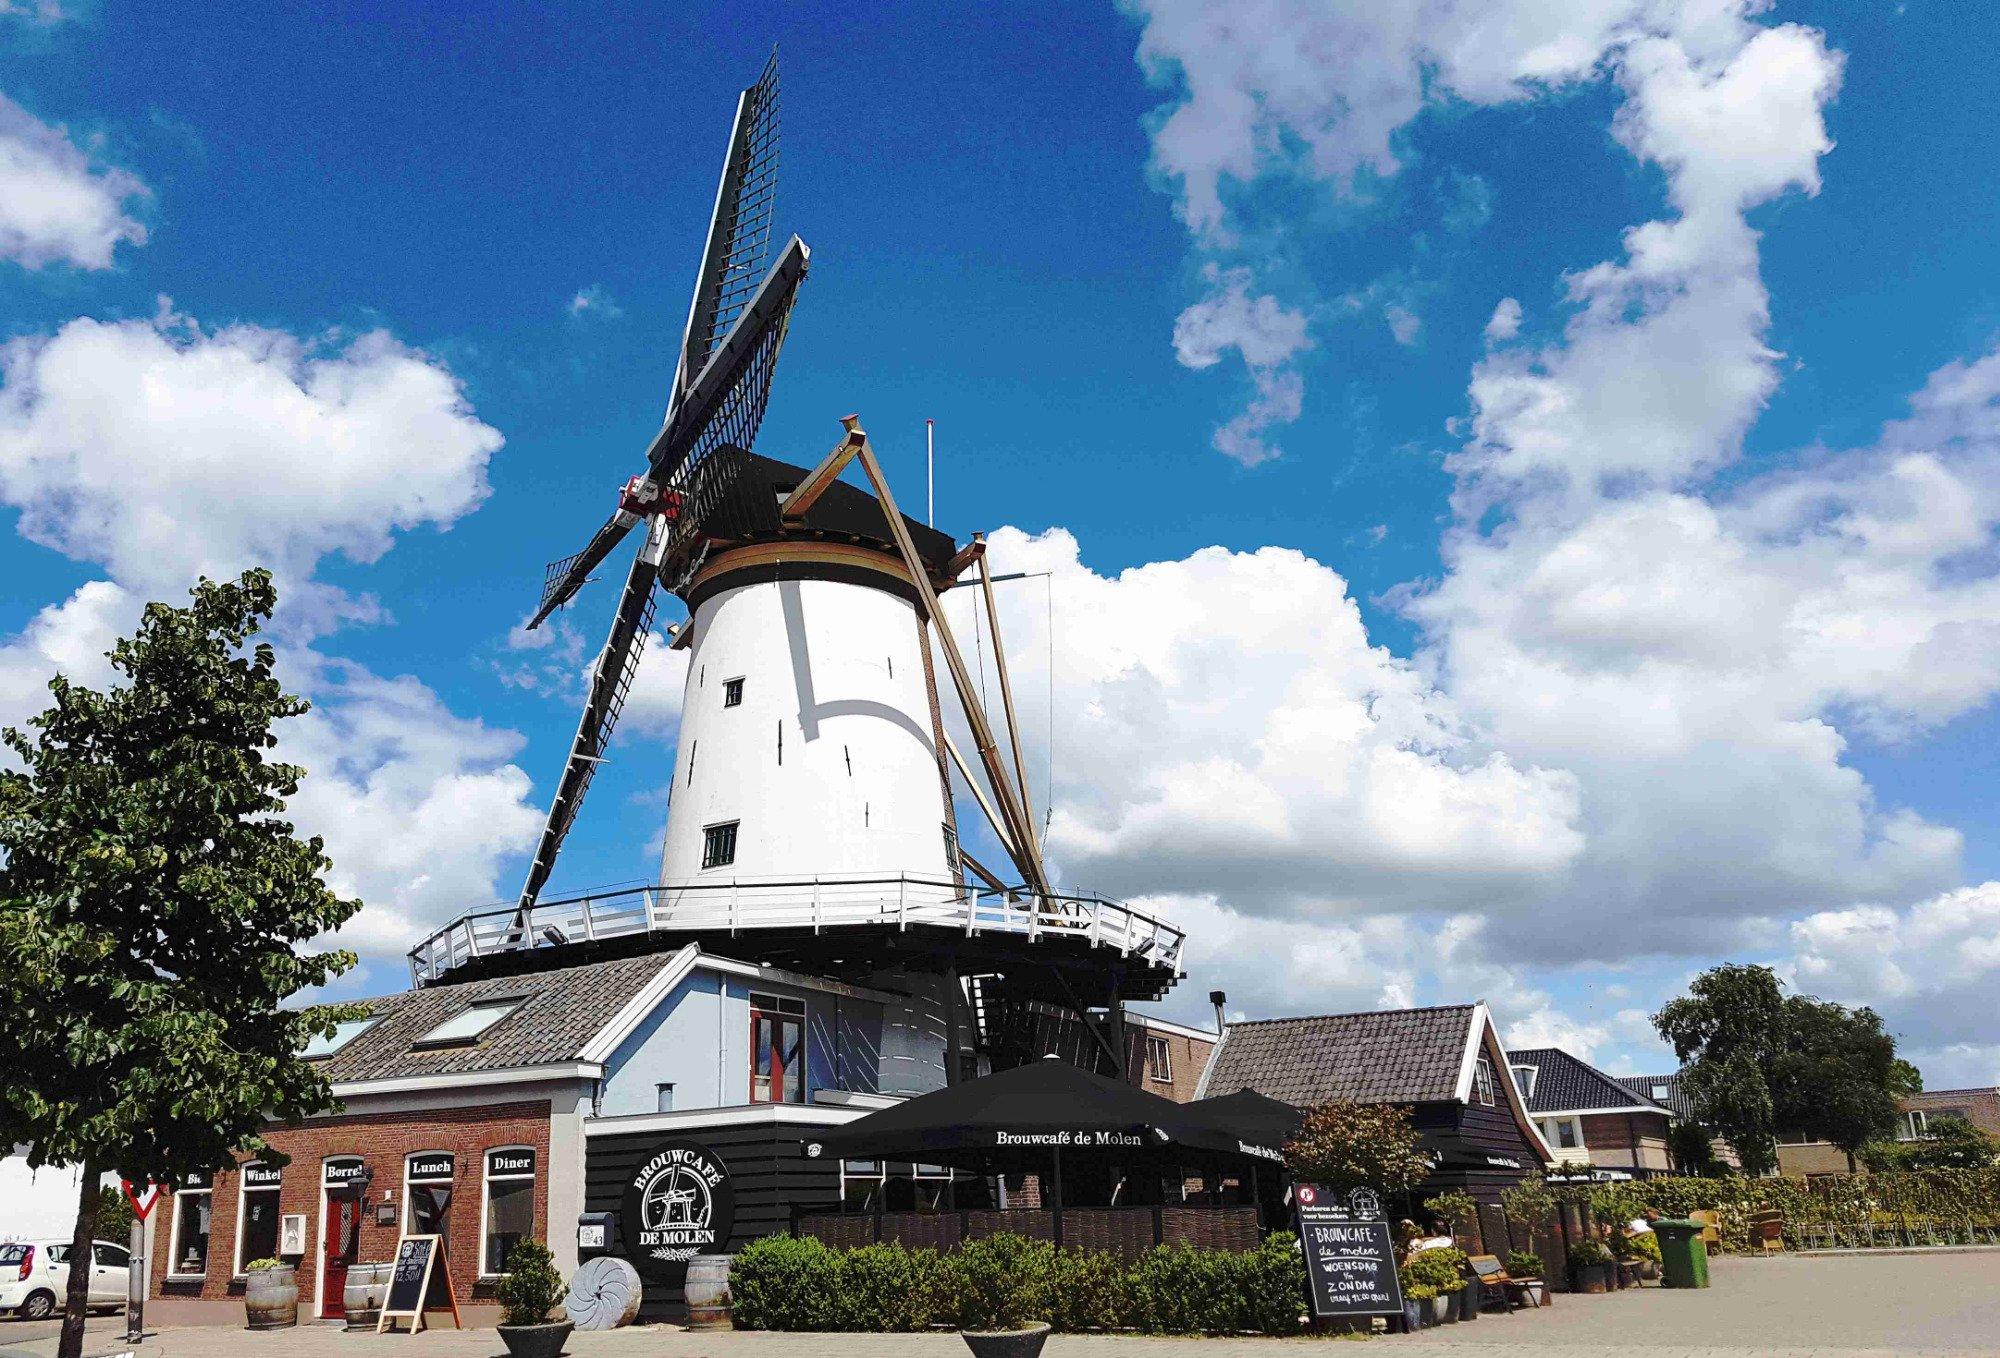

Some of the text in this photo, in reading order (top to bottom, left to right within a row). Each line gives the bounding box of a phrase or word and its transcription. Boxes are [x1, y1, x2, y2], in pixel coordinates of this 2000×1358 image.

[996, 1130, 1071, 1145] Brouwcafé
[1074, 1131, 1092, 1145] de
[1095, 1131, 1141, 1146] Molen
[412, 1160, 451, 1174] Lunch
[494, 1157, 531, 1169] Diner
[247, 1168, 280, 1181] Winkel
[633, 1149, 724, 1192] BROUWCAFÉ
[592, 1236, 603, 1246] 43
[639, 1230, 715, 1245] DE MOLEN
[1315, 1227, 1373, 1243] BROUWCAFE
[1319, 1246, 1379, 1256] de molen
[1322, 1261, 1377, 1273] WOENSDAG
[1328, 1280, 1375, 1292] ZONDAG
